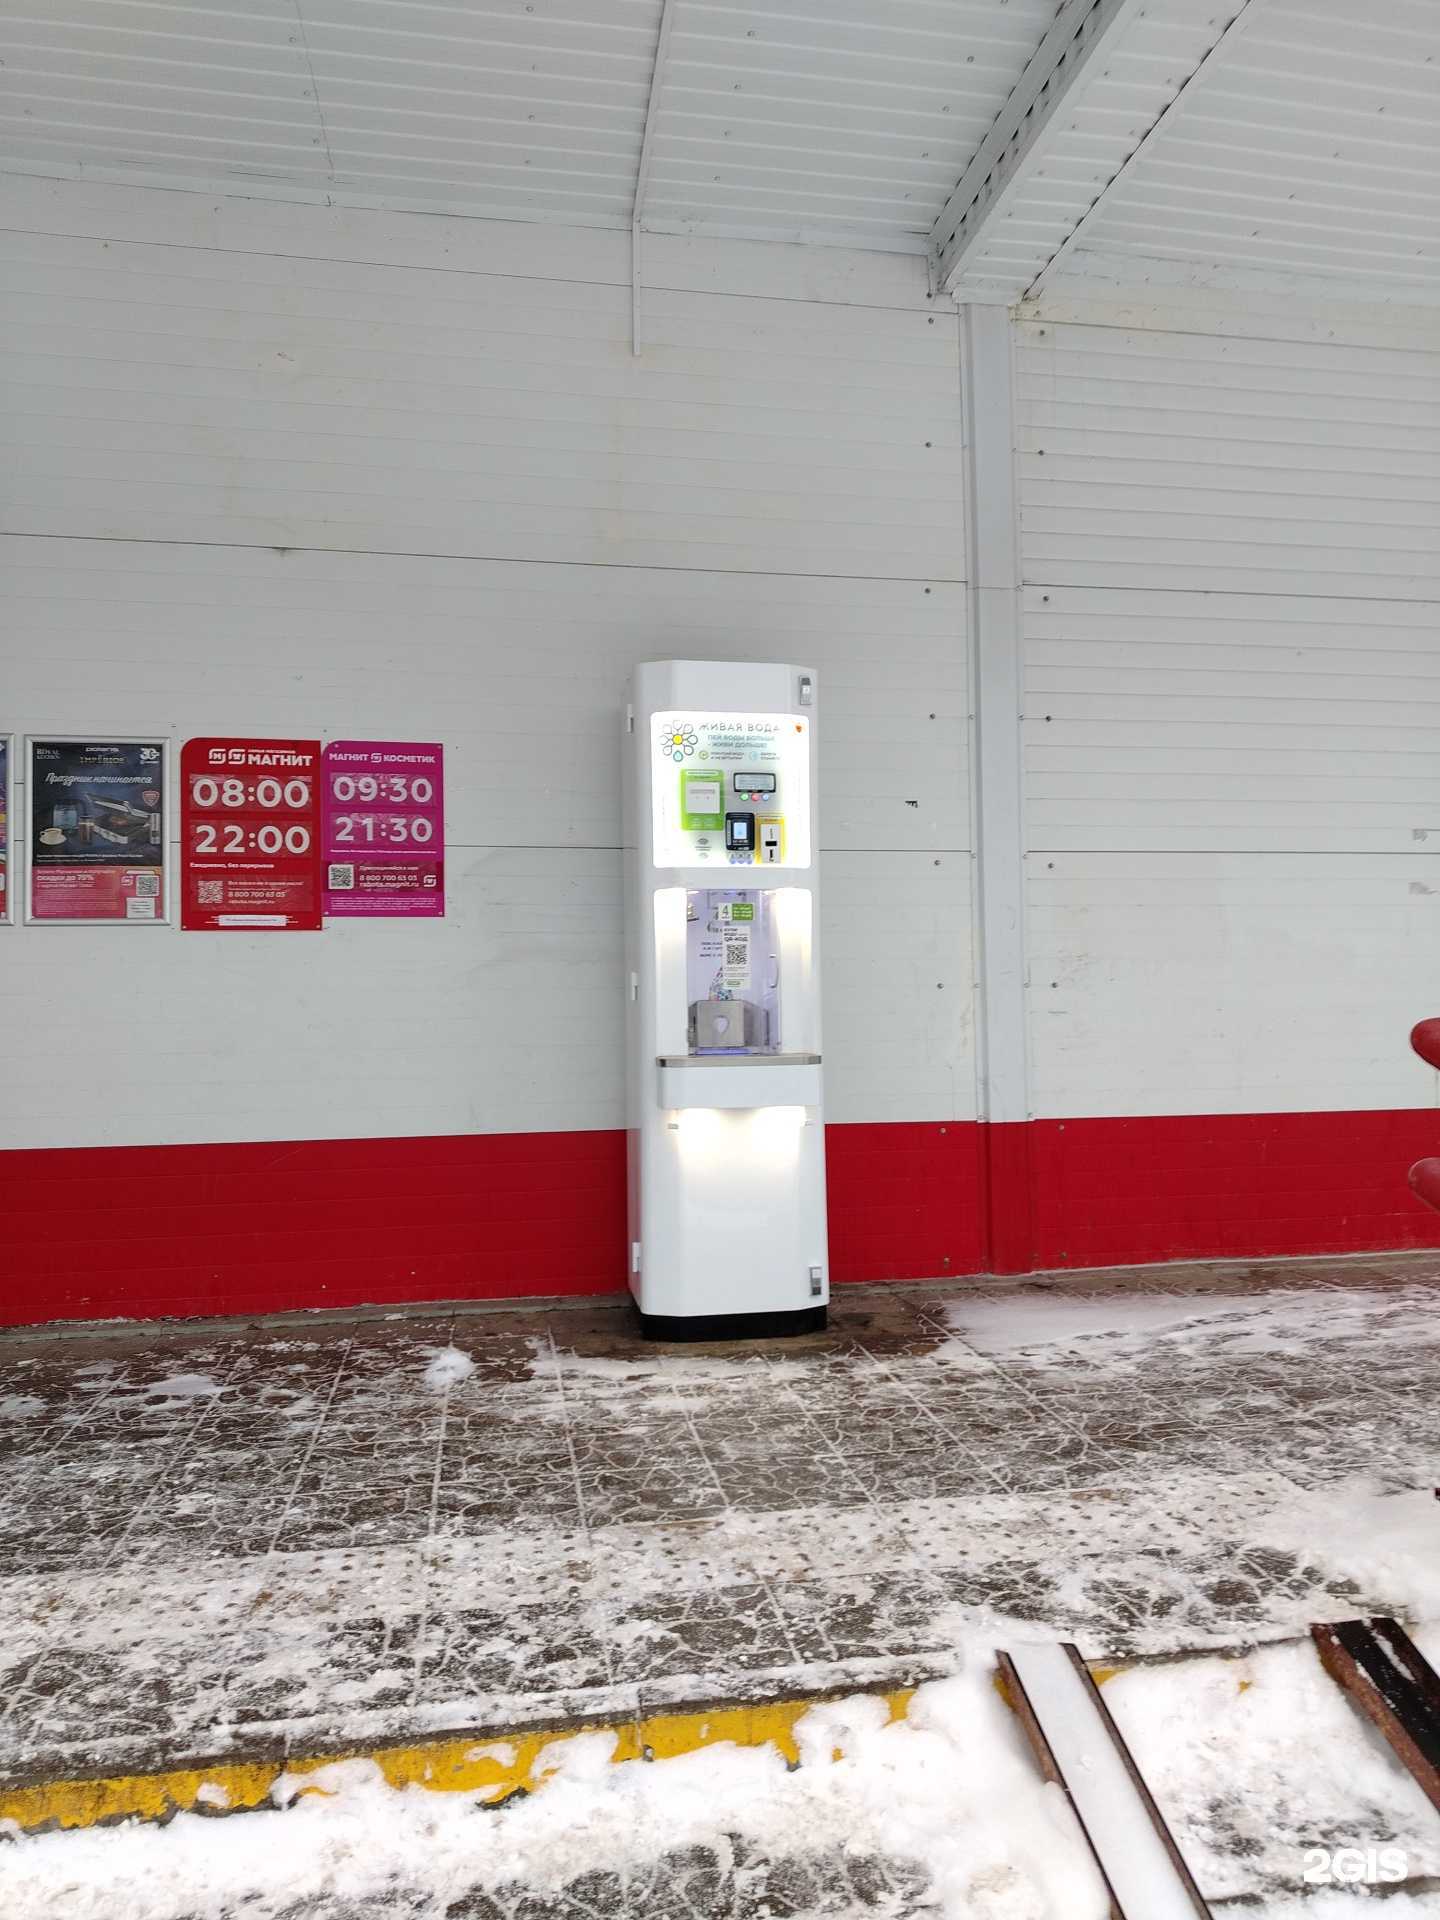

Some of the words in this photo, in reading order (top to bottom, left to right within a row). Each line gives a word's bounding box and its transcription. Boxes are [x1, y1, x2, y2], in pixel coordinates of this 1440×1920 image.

[699, 723, 743, 732] ЖИВАЯ
[748, 723, 780, 732] ВОДА
[247, 753, 313, 766] МАГНИТ
[329, 753, 369, 762] МАГНИТ
[383, 754, 436, 763] КОСМЕТИК
[192, 778, 310, 808] 08:00
[333, 776, 433, 803] 09:30
[195, 824, 311, 854] 22:00
[335, 816, 433, 843] 21:30
